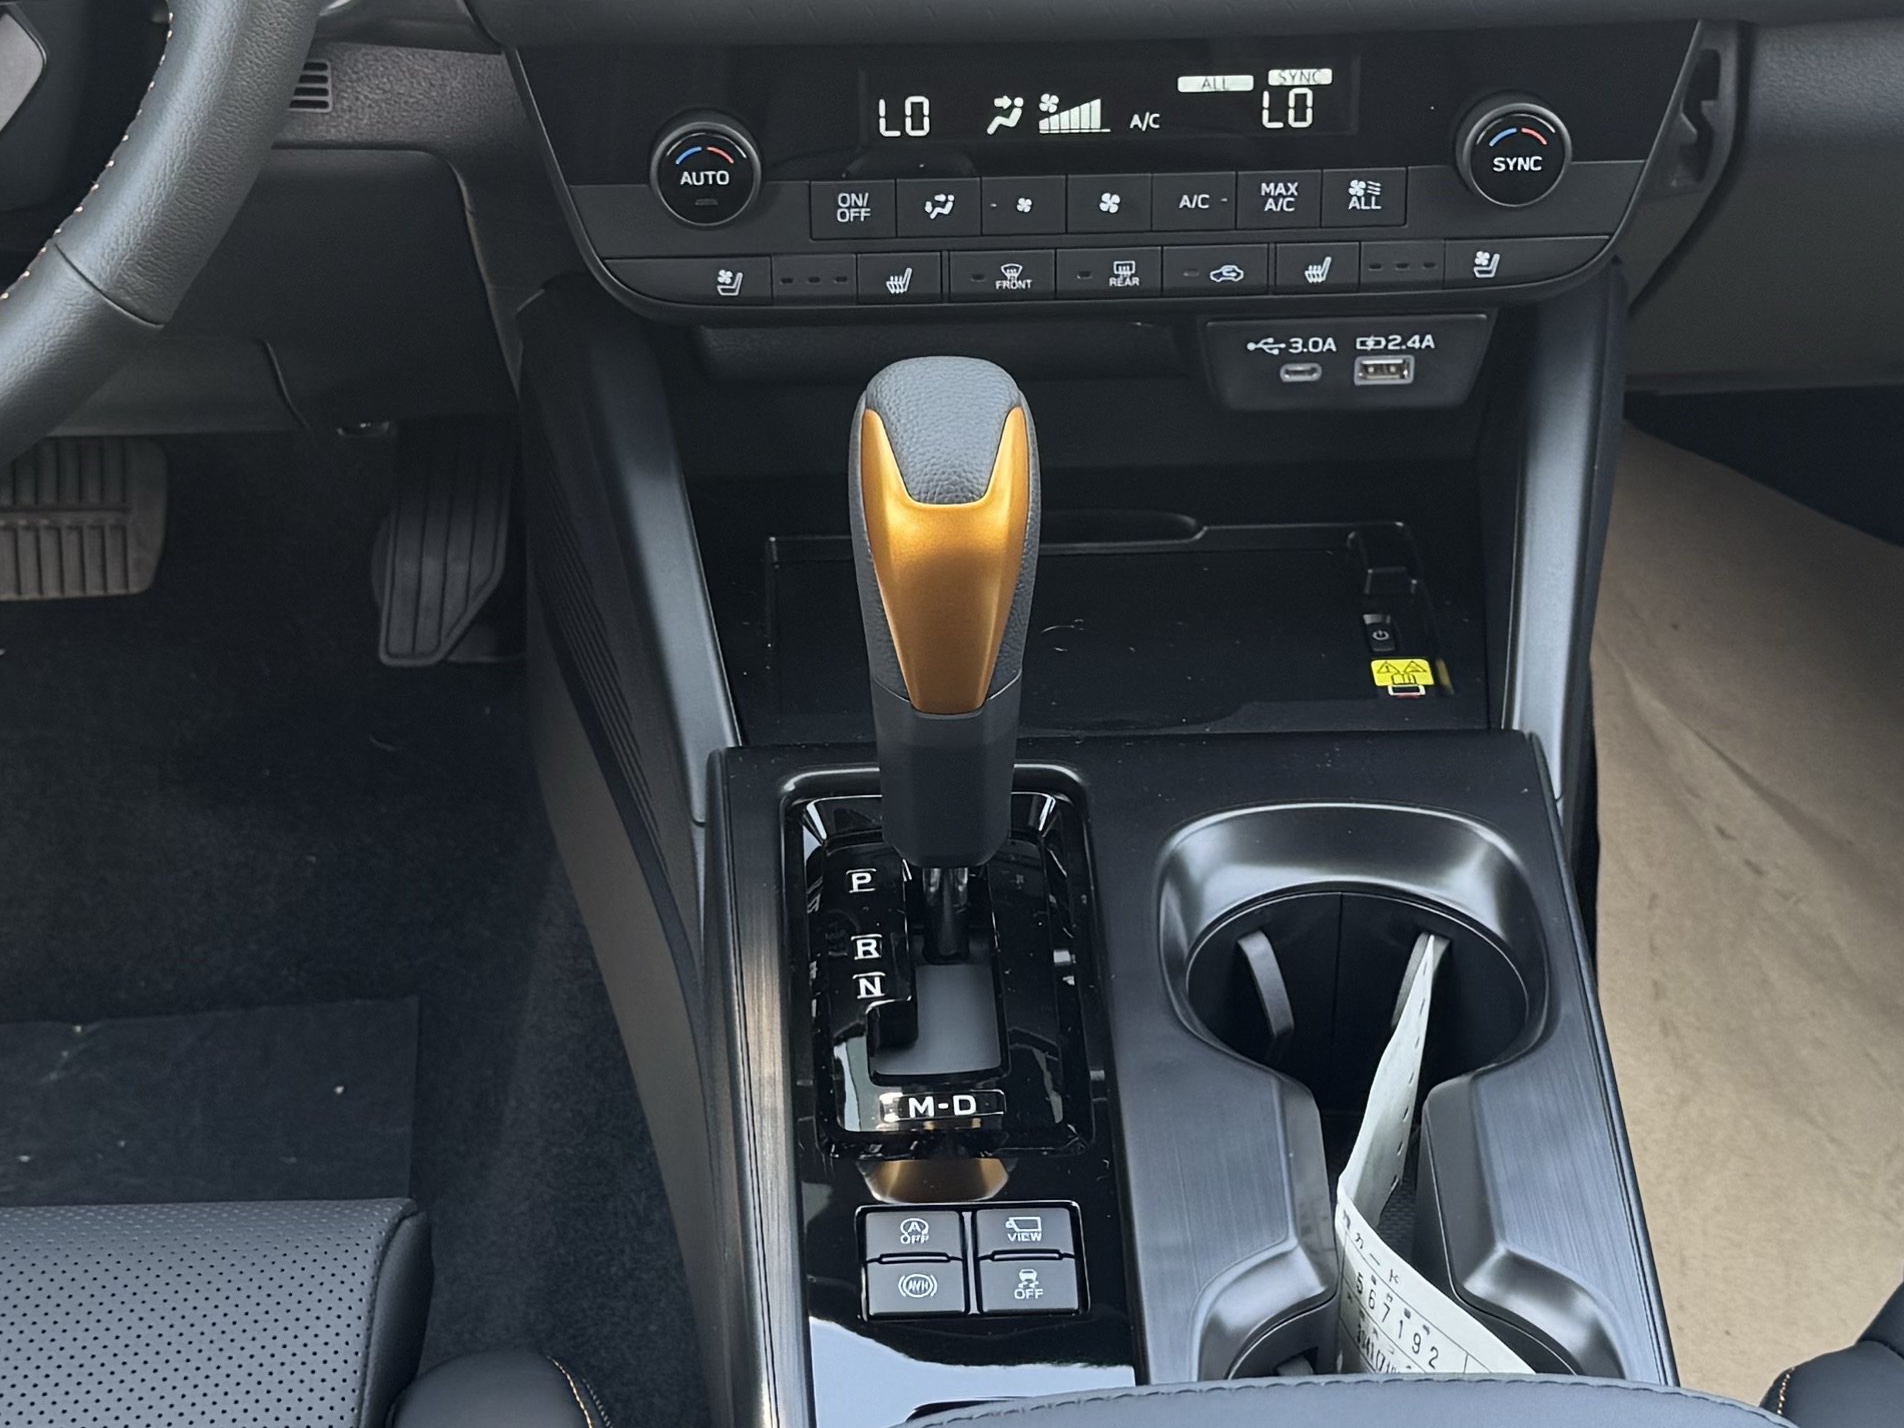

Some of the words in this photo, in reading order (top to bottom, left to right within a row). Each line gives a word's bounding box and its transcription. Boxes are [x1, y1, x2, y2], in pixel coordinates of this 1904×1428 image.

[1200, 77, 1229, 91] ALL
[1277, 70, 1321, 84] SYNC
[1262, 87, 1313, 129] LO
[878, 95, 929, 137] LO
[1129, 112, 1161, 131] A/C
[1492, 155, 1542, 172] SYNC
[680, 170, 730, 186] AUTO
[1261, 182, 1298, 197] MAX
[837, 192, 869, 209] ON/
[1179, 194, 1210, 209] A/C
[1264, 197, 1296, 212] A/C
[1348, 196, 1382, 210] ALL
[836, 208, 871, 223] OFF
[995, 278, 1033, 290] FRONT
[1109, 275, 1140, 287] REAR
[1288, 337, 1337, 353] 3.0A
[1387, 334, 1435, 350] 2.4A
[848, 869, 876, 893] P
[853, 935, 883, 960] R
[855, 973, 886, 999] N
[900, 1234, 929, 1244] OFF
[1007, 1232, 1042, 1242] VIEW
[1014, 1288, 1044, 1300] OFF
